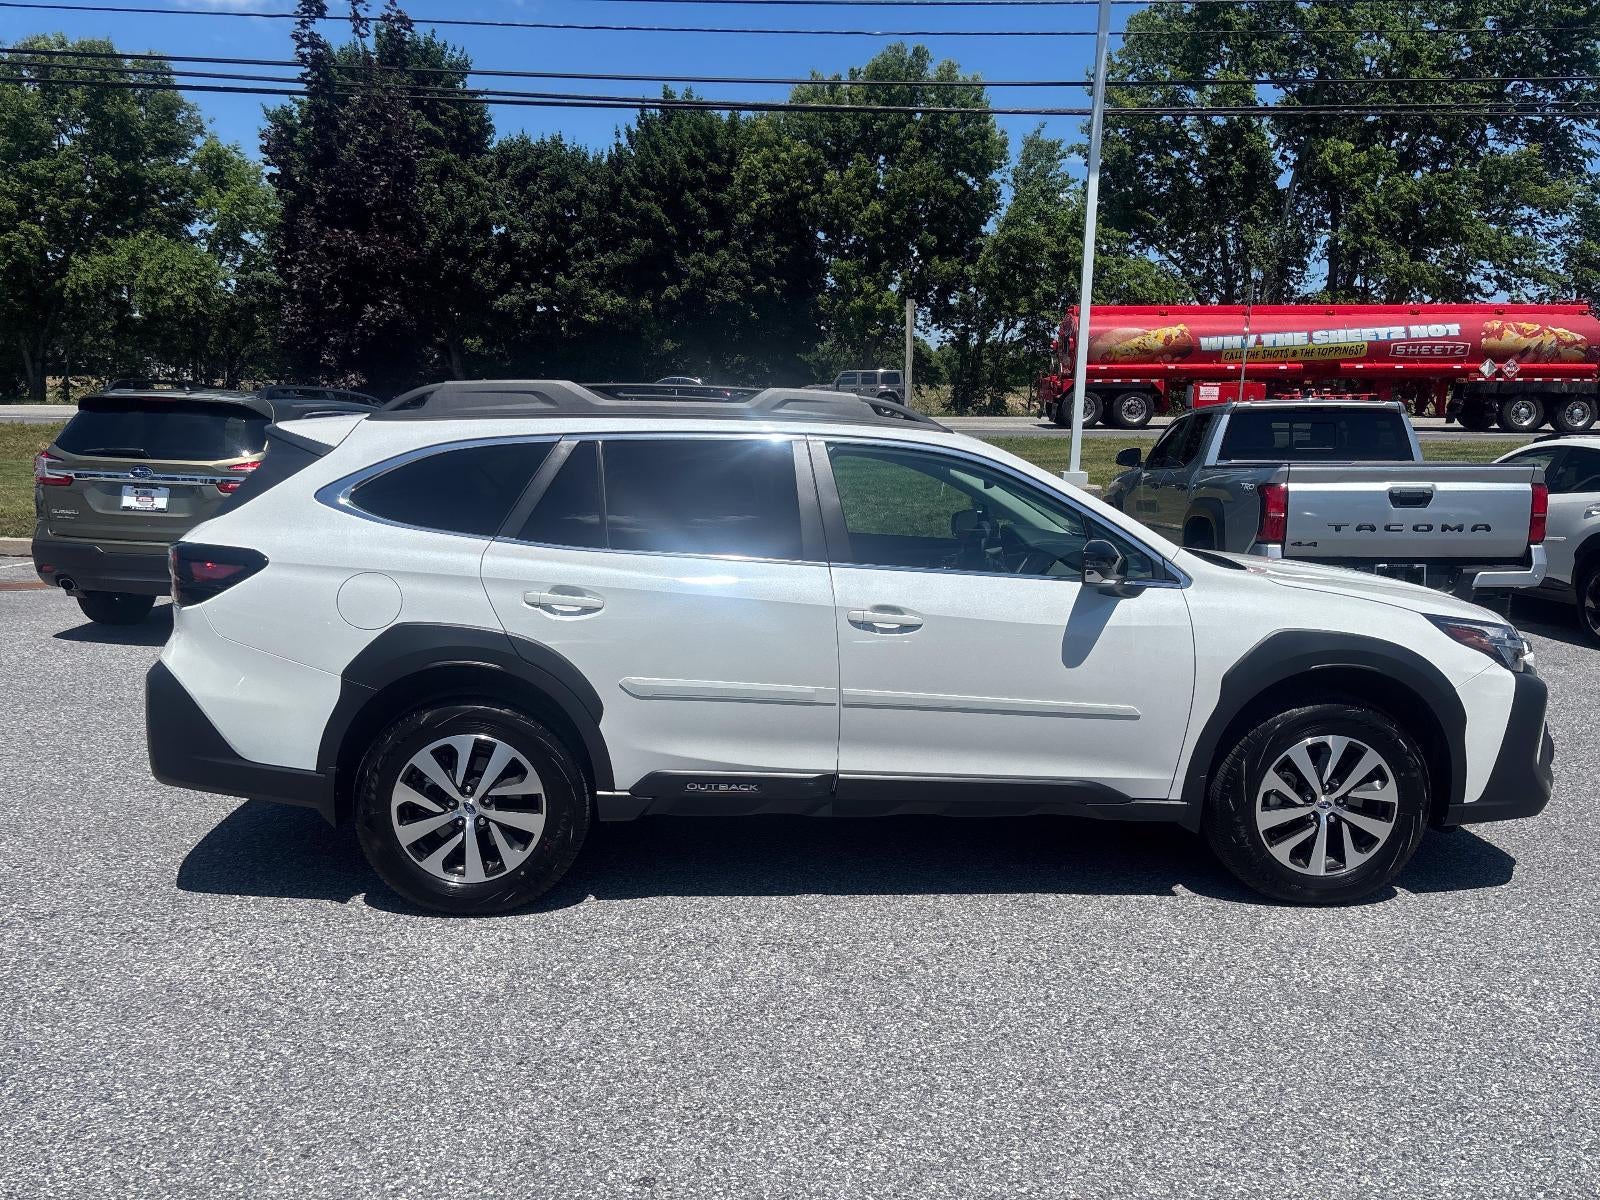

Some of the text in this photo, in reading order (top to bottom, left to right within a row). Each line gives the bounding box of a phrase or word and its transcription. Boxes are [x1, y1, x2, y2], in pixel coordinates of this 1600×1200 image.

[1260, 332, 1308, 347] THE
[1312, 326, 1406, 345] SHEETZ
[1409, 323, 1460, 338] NOT
[1224, 351, 1243, 361] CALL
[1262, 348, 1289, 360] SHOTS
[1300, 347, 1316, 358] THE
[1317, 342, 1365, 357] TOPPINGS?
[1395, 345, 1465, 355] SHEETZ
[1327, 523, 1492, 533] TACOMA
[686, 782, 759, 791] OUTBACK
